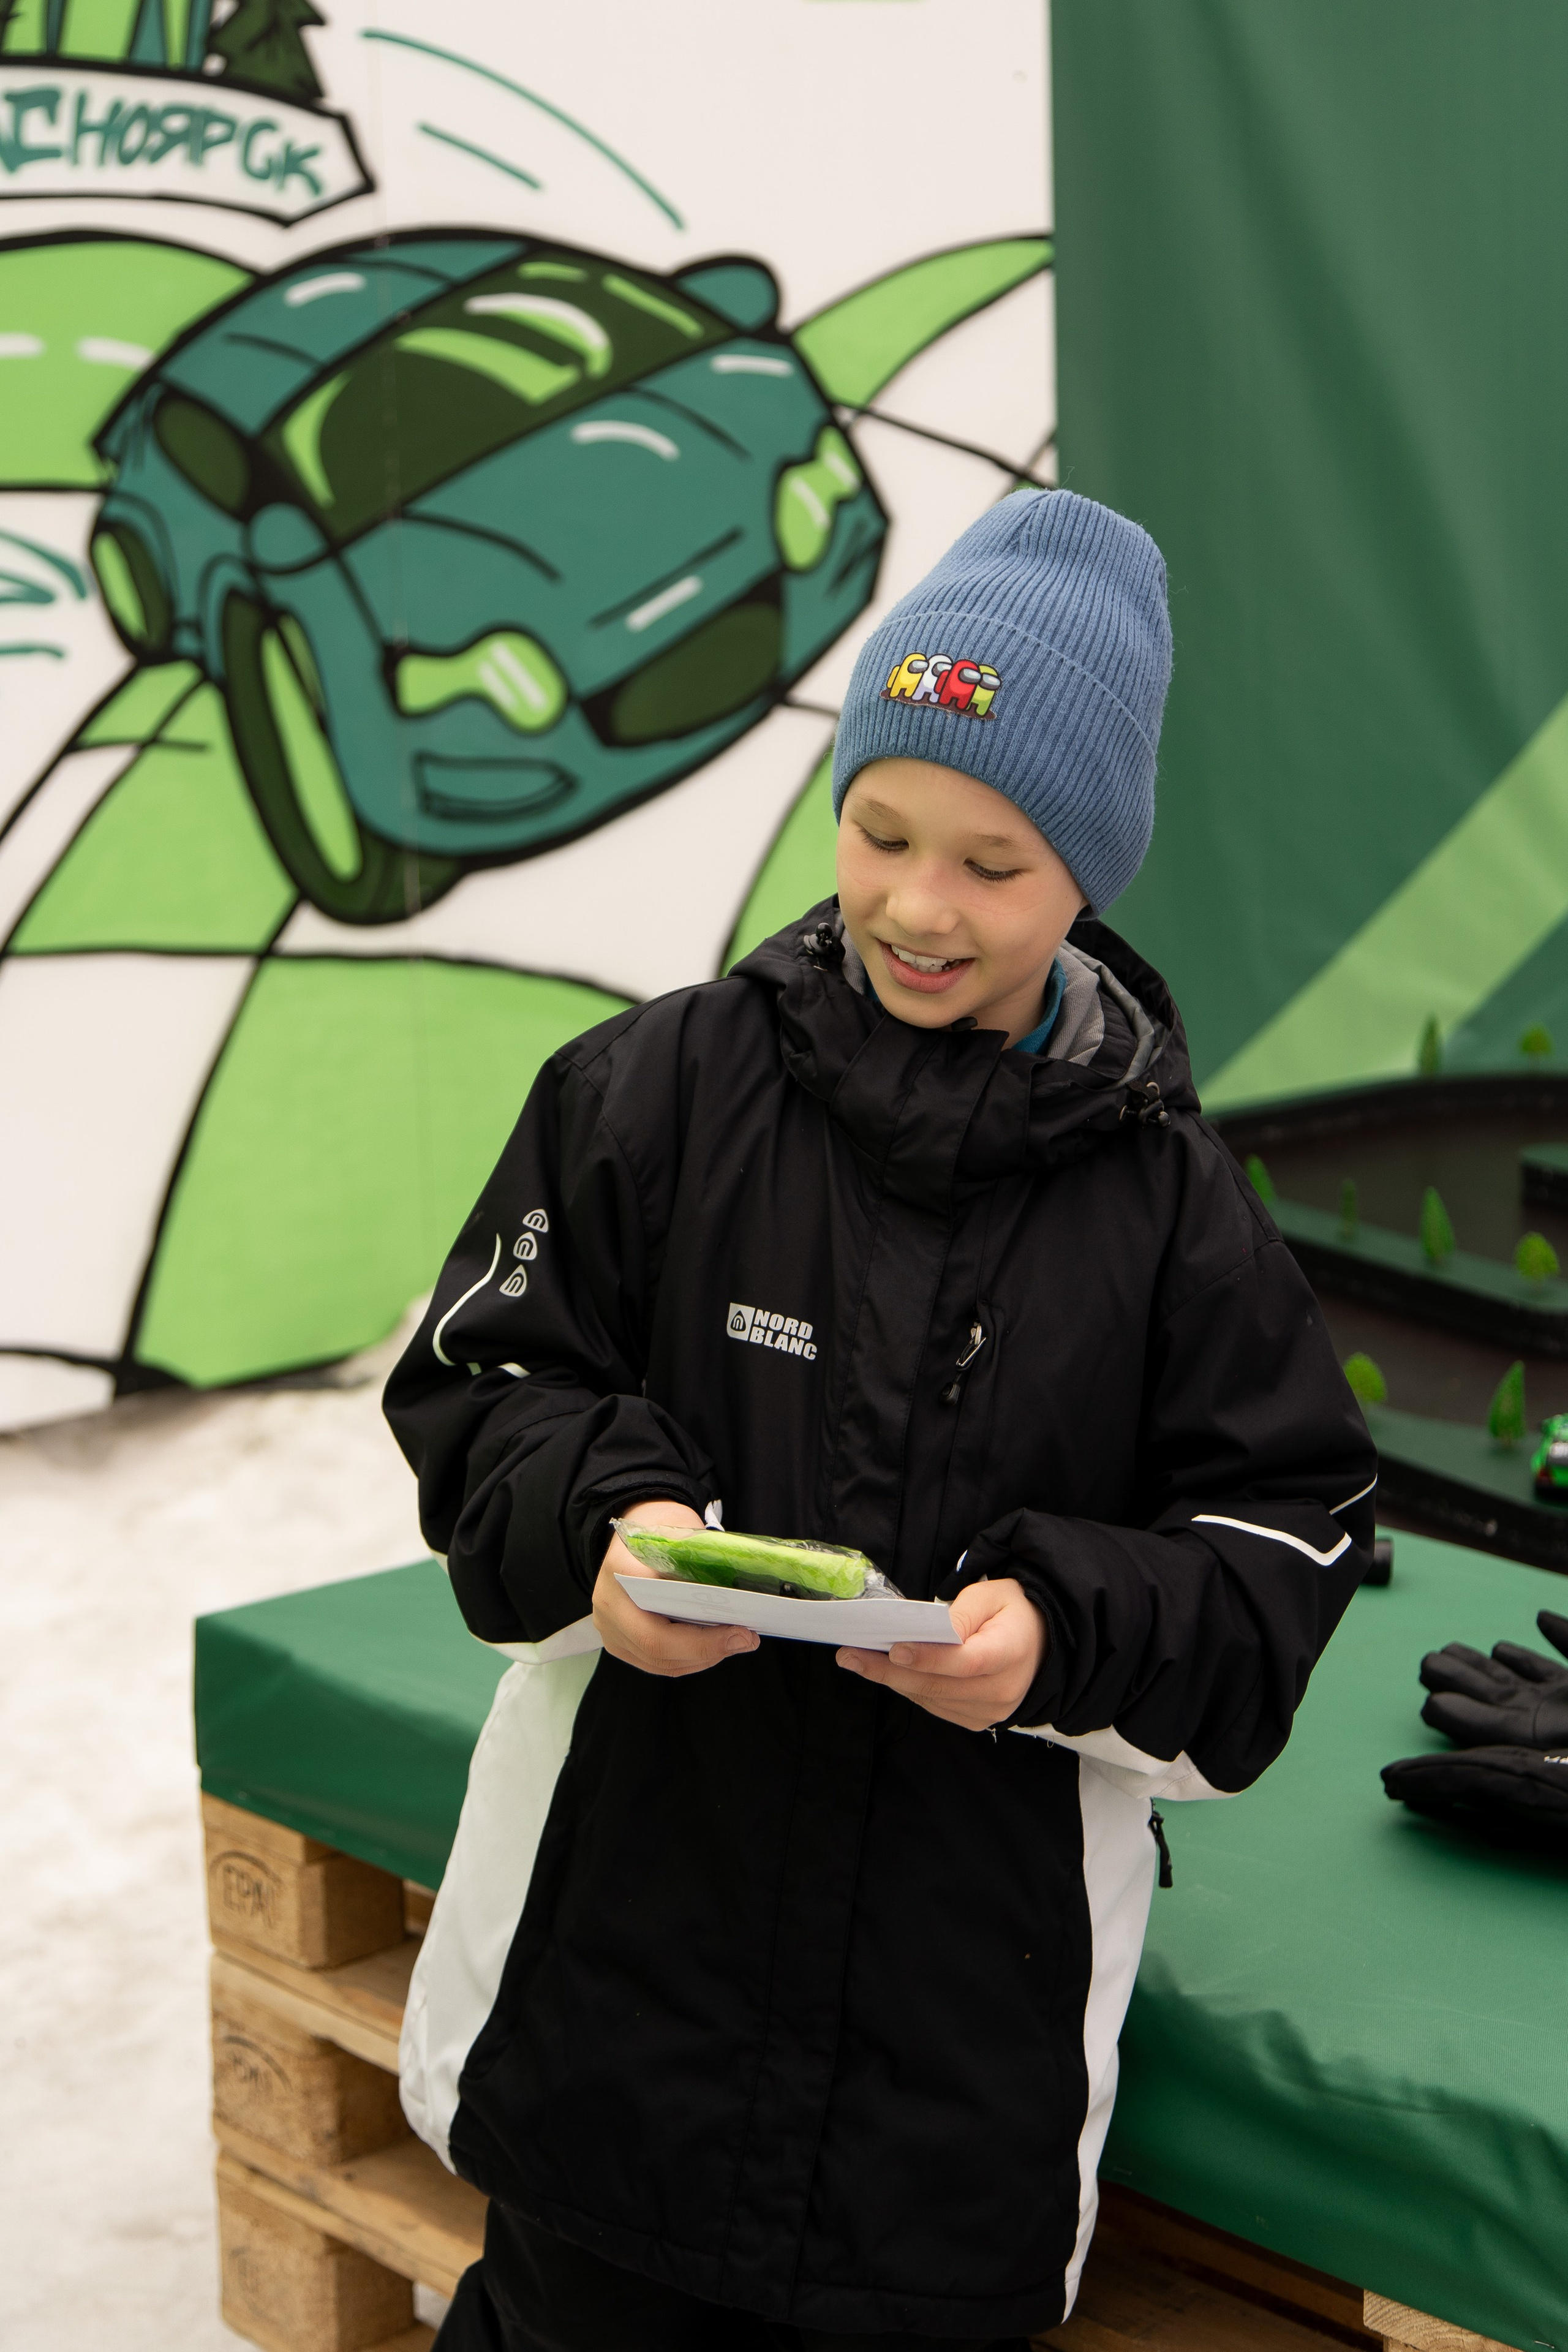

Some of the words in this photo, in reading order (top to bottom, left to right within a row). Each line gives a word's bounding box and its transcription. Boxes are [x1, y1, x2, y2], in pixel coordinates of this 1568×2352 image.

[0, 85, 322, 195] СНОЯРСК
[753, 1309, 813, 1340] NORD
[749, 1326, 818, 1360] BLANC
